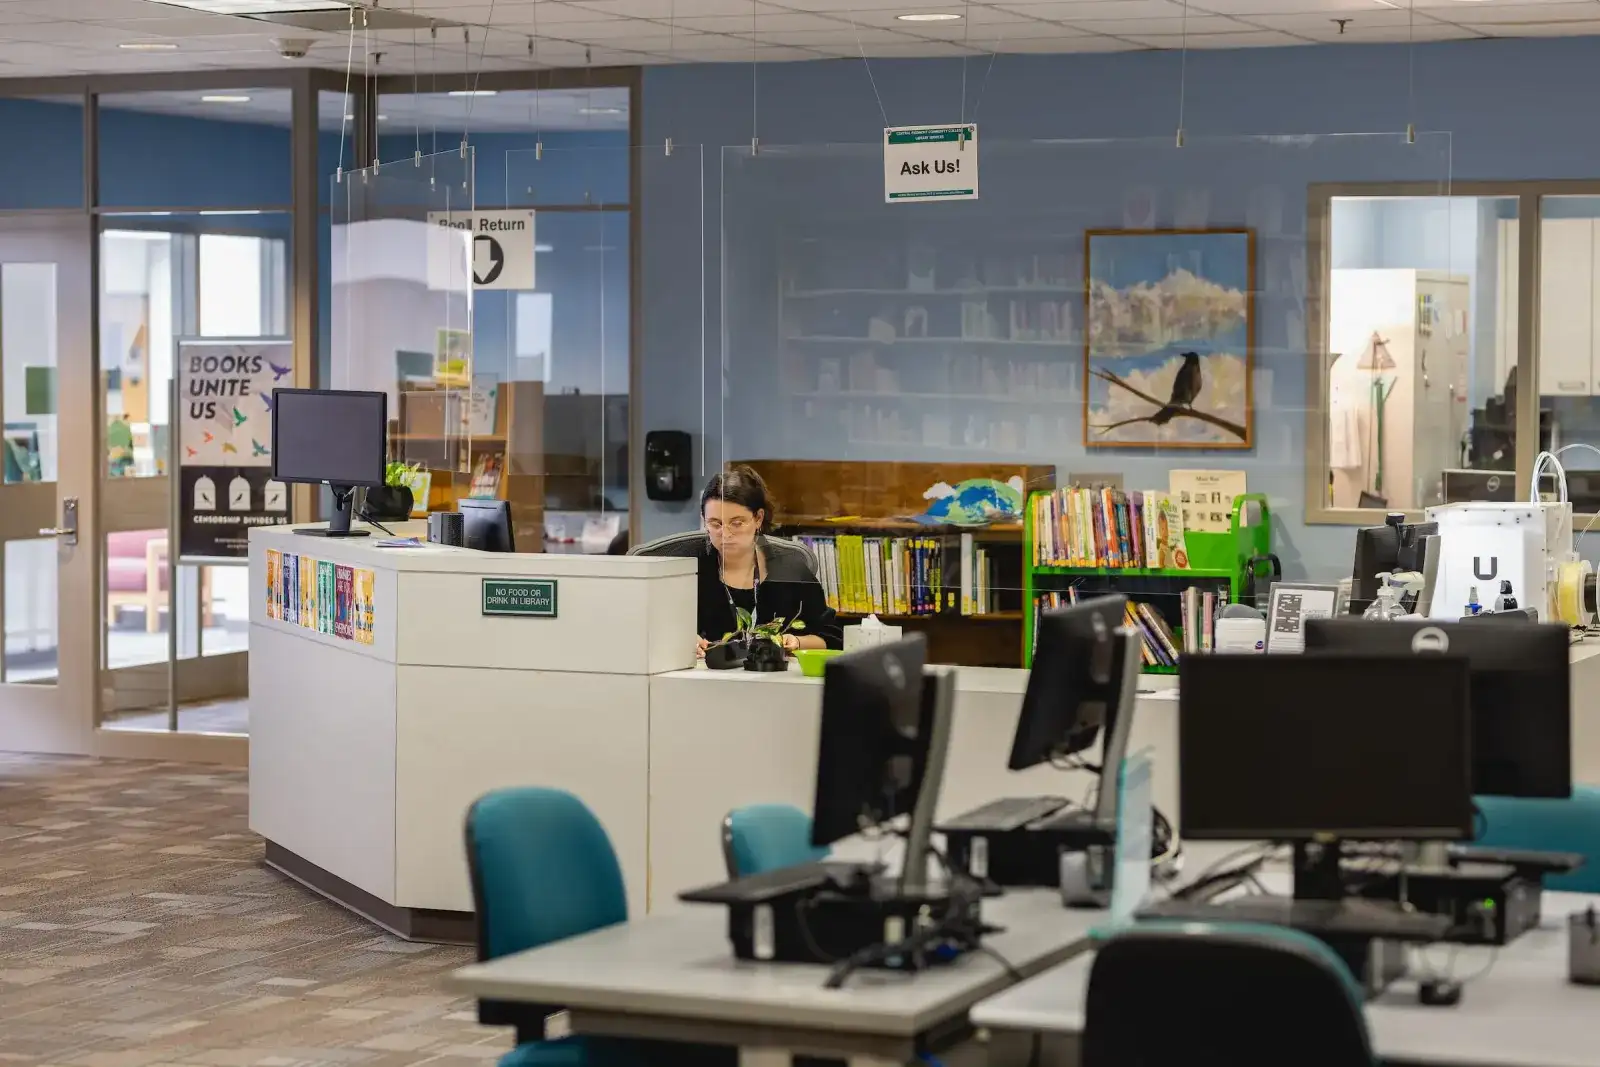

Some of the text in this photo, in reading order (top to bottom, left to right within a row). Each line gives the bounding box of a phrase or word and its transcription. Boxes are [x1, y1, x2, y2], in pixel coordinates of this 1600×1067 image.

[900, 159, 960, 175] Ask Us!
[439, 218, 525, 231] Boo Return
[189, 356, 263, 374] BOOKS
[189, 378, 251, 396] UNITE
[189, 402, 216, 419] US
[193, 515, 288, 524] CENSORSHIP DIVIDES US
[1473, 556, 1498, 580] U
[495, 588, 507, 596] NO
[530, 589, 541, 597] OR
[510, 597, 518, 605] IN
[519, 597, 550, 605] LIBRARY
